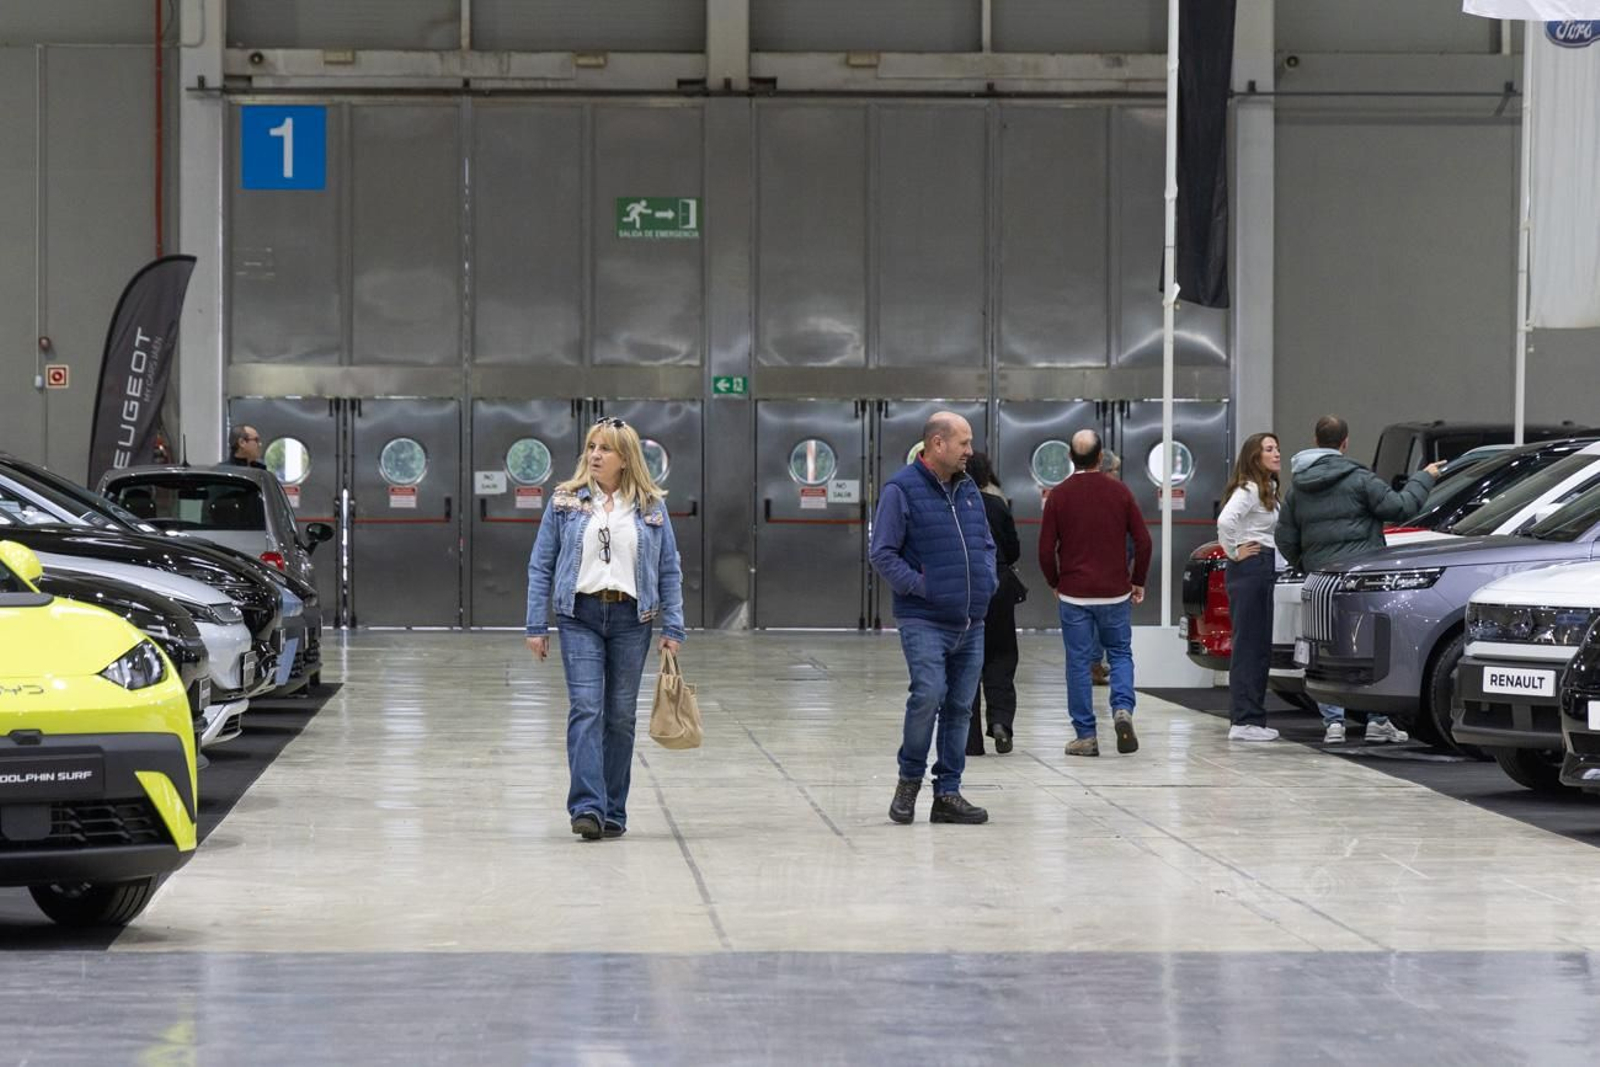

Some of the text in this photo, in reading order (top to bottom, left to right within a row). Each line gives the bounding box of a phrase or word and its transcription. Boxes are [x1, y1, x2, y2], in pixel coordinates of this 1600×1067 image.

[269, 117, 294, 178] 1
[113, 326, 150, 469] EUGEOT
[1490, 673, 1546, 689] RENAULT
[57, 771, 92, 781] SURF
